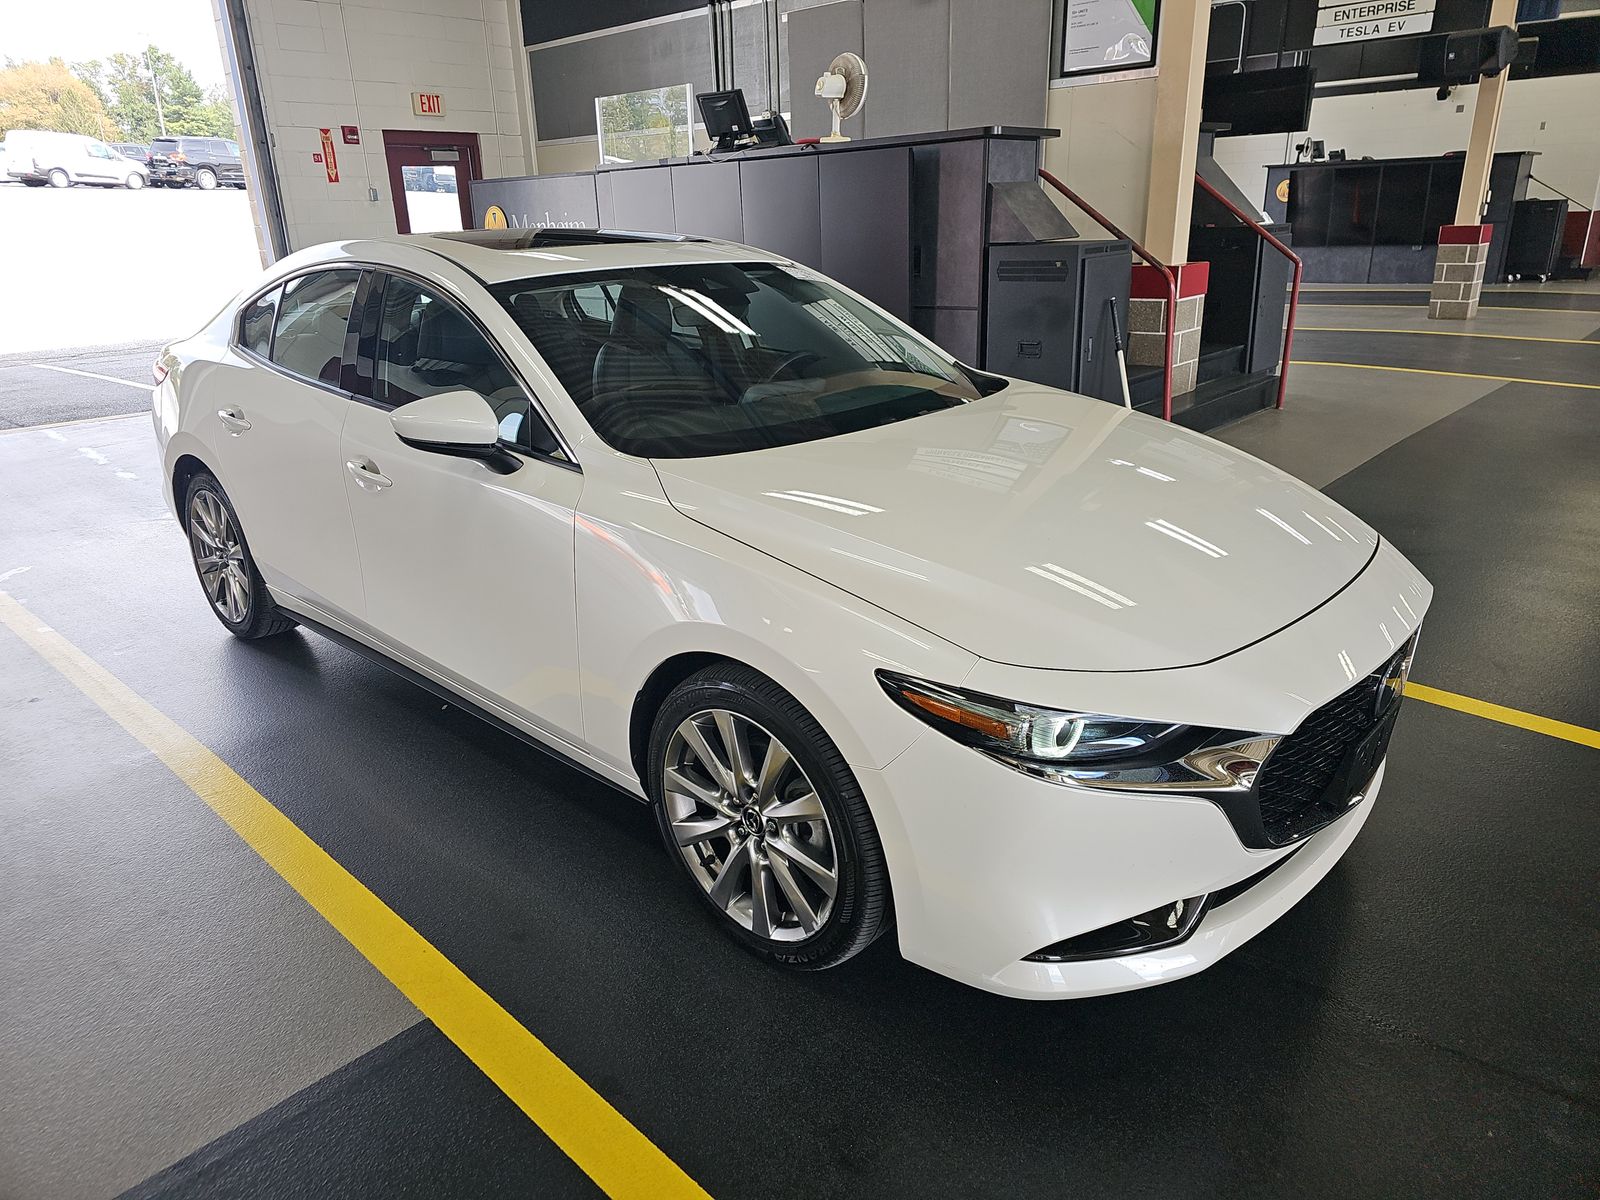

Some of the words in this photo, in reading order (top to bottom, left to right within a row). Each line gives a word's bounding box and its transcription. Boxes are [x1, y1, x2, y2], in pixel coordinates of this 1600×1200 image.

[1333, 0, 1416, 22] ENTERPRISE
[1340, 24, 1381, 39] TESLA
[1388, 20, 1407, 33] EV
[420, 94, 441, 114] EXIT
